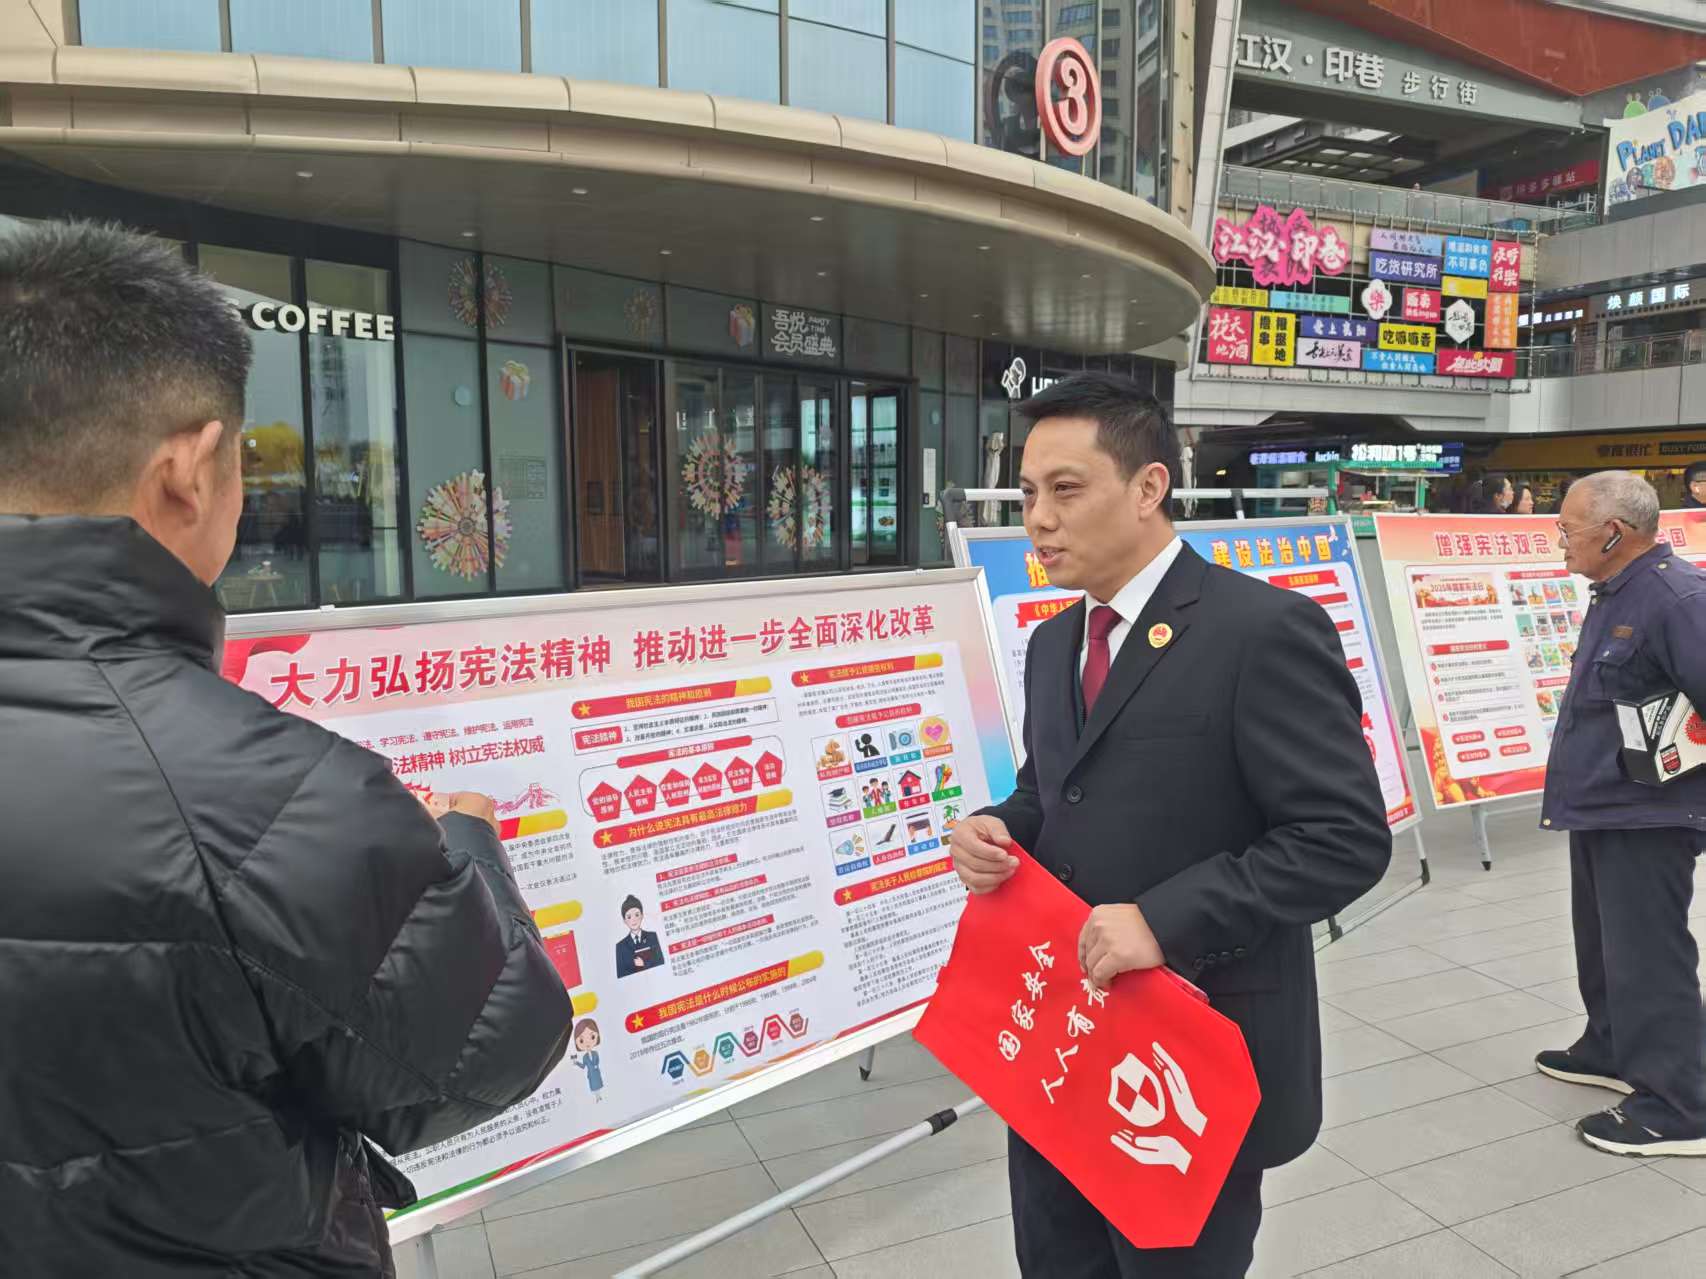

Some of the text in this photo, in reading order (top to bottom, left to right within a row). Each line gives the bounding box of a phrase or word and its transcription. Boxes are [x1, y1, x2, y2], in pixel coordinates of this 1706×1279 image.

[1402, 72, 1477, 104] 步行街
[1375, 258, 1438, 279] 吃货研究所
[251, 300, 396, 341] COFFEE
[1383, 330, 1432, 348] 吃嘛嘛香
[1211, 534, 1332, 570] 建设法治中国
[269, 633, 612, 710] 大力弘扬宪法精神
[632, 603, 936, 669] 推动进一步全面深化改革
[449, 734, 546, 768] 树立宪法权威
[998, 941, 1055, 1061] 国家安全
